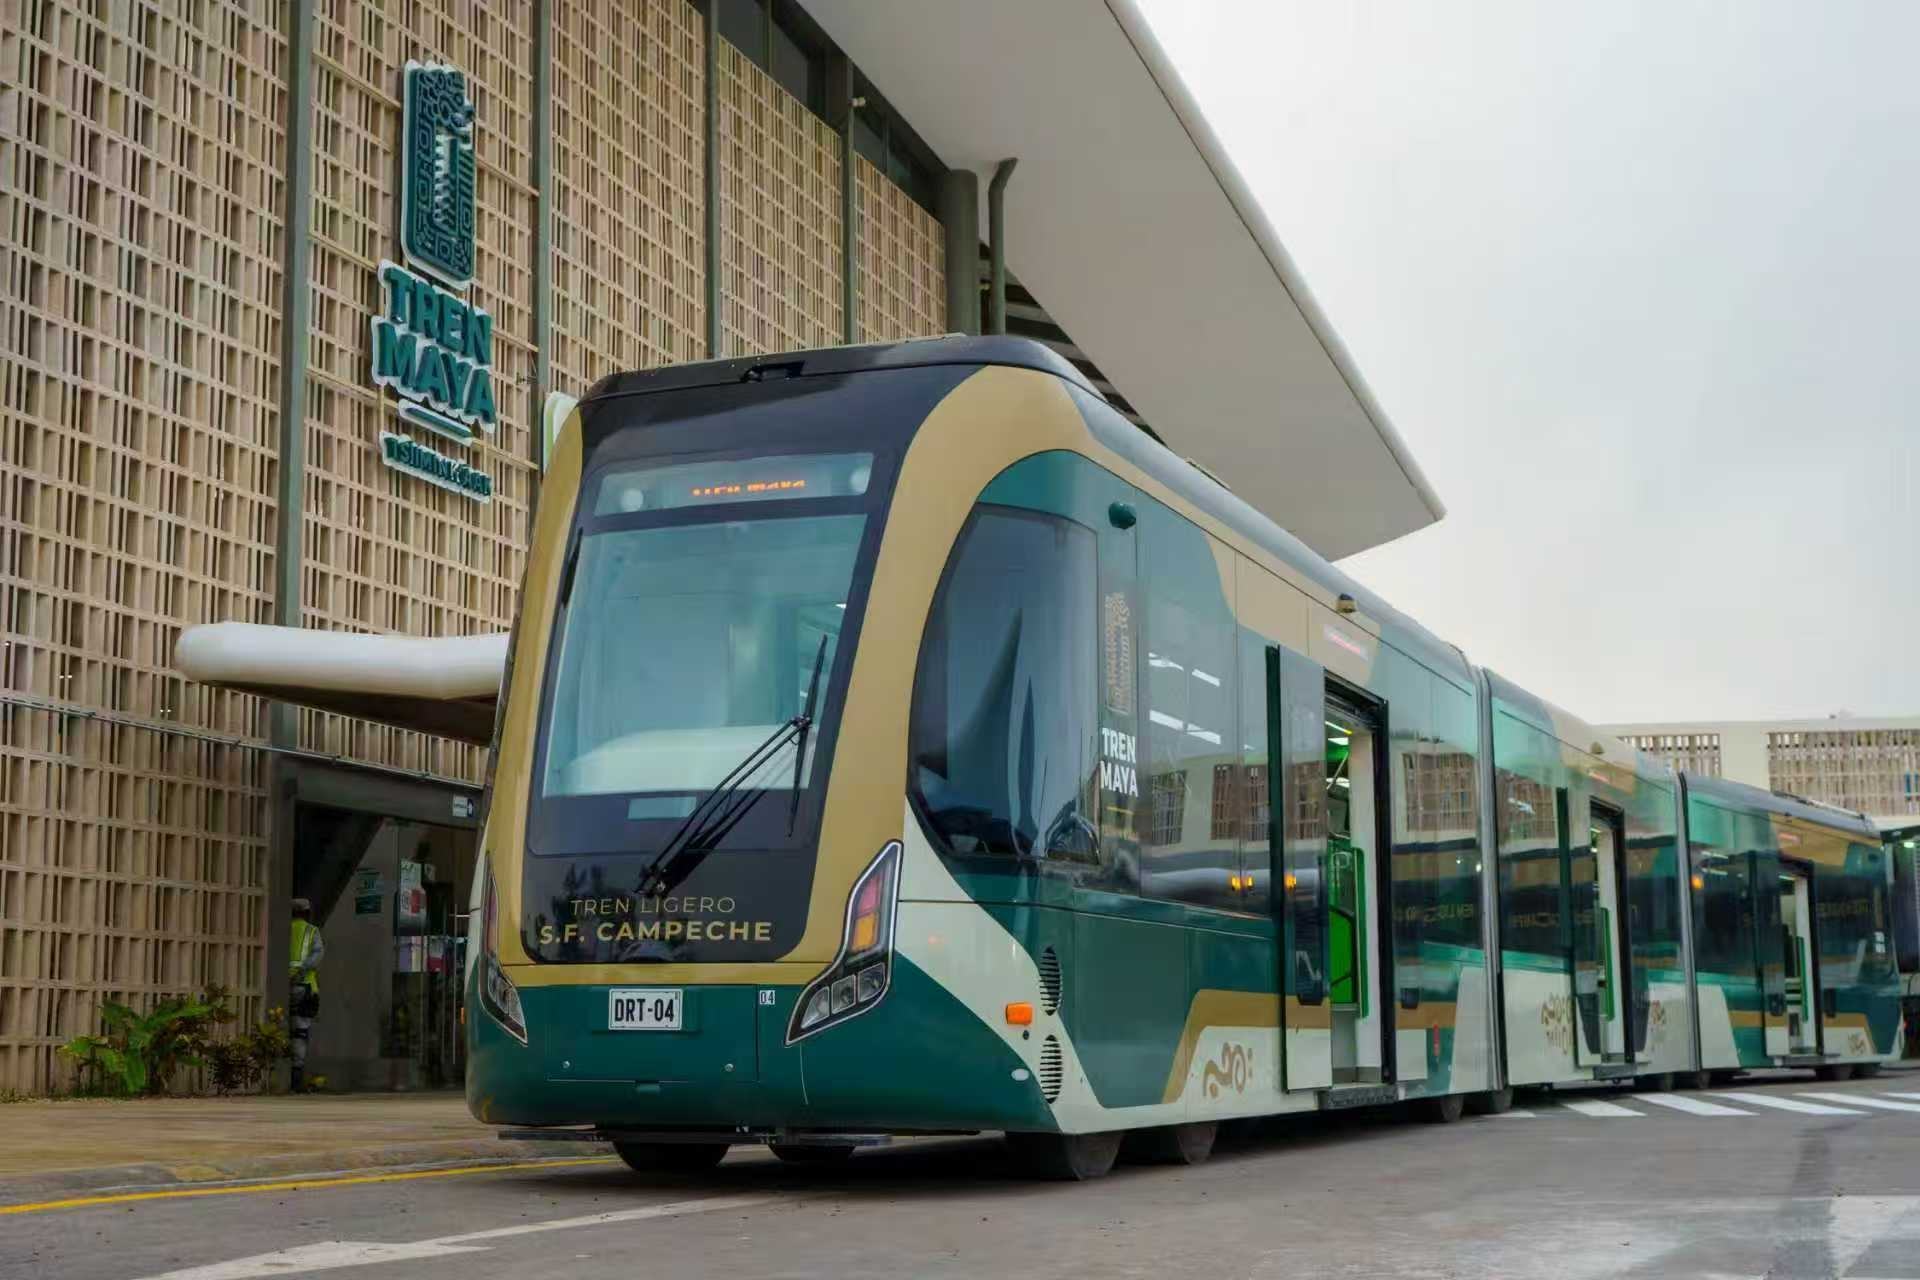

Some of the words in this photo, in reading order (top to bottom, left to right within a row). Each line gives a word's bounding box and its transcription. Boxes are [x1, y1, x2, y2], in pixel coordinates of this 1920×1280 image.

[383, 266, 492, 365] TREN
[377, 321, 496, 424] MAYA
[1101, 727, 1136, 764] TREN
[1100, 760, 1138, 798] MAYA
[571, 898, 631, 916] TREN
[641, 897, 736, 914] LIGERO
[539, 923, 585, 945] S.F.
[596, 920, 772, 942] CAMPECHE
[614, 998, 675, 1022] DRT-04
[760, 991, 774, 1004] 04
